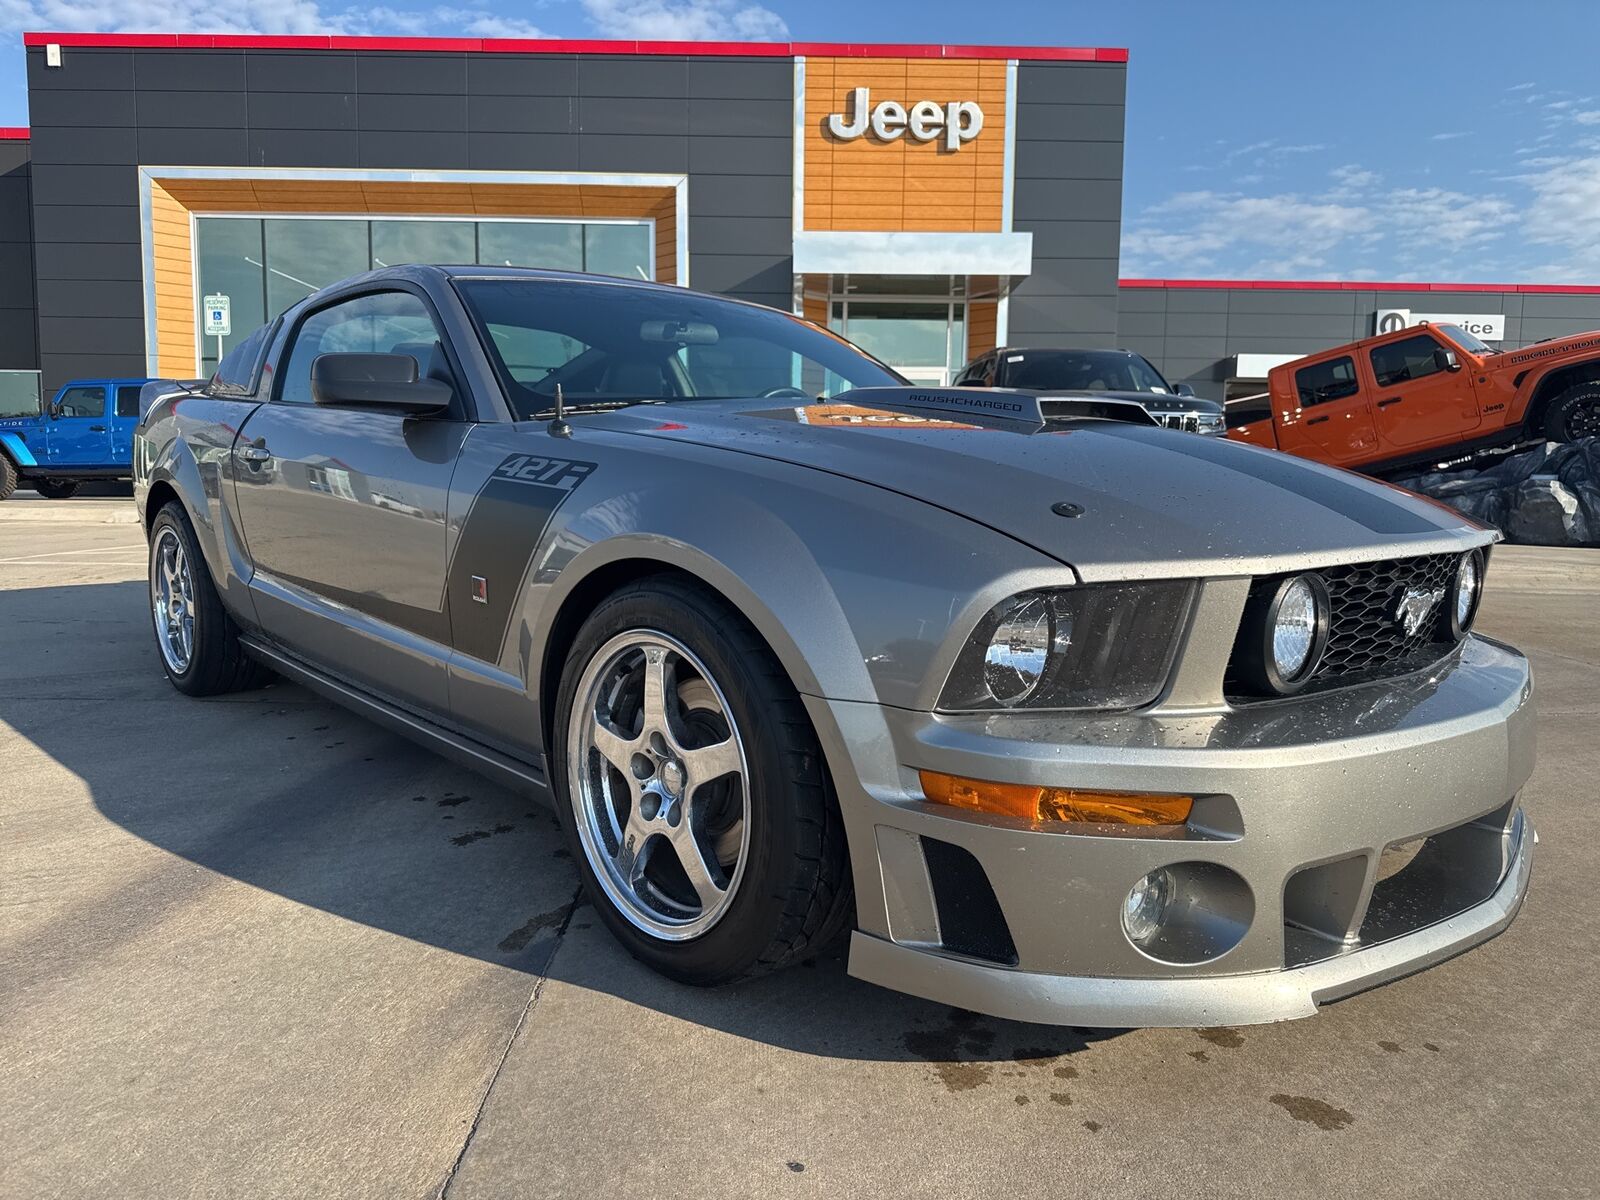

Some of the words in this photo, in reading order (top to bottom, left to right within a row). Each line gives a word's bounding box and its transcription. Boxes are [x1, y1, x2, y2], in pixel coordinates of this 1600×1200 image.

[828, 86, 984, 151] Jeep
[909, 394, 1022, 412] ROUSHCHARGED
[1483, 402, 1505, 413] Jeep
[498, 455, 598, 489] 427R
